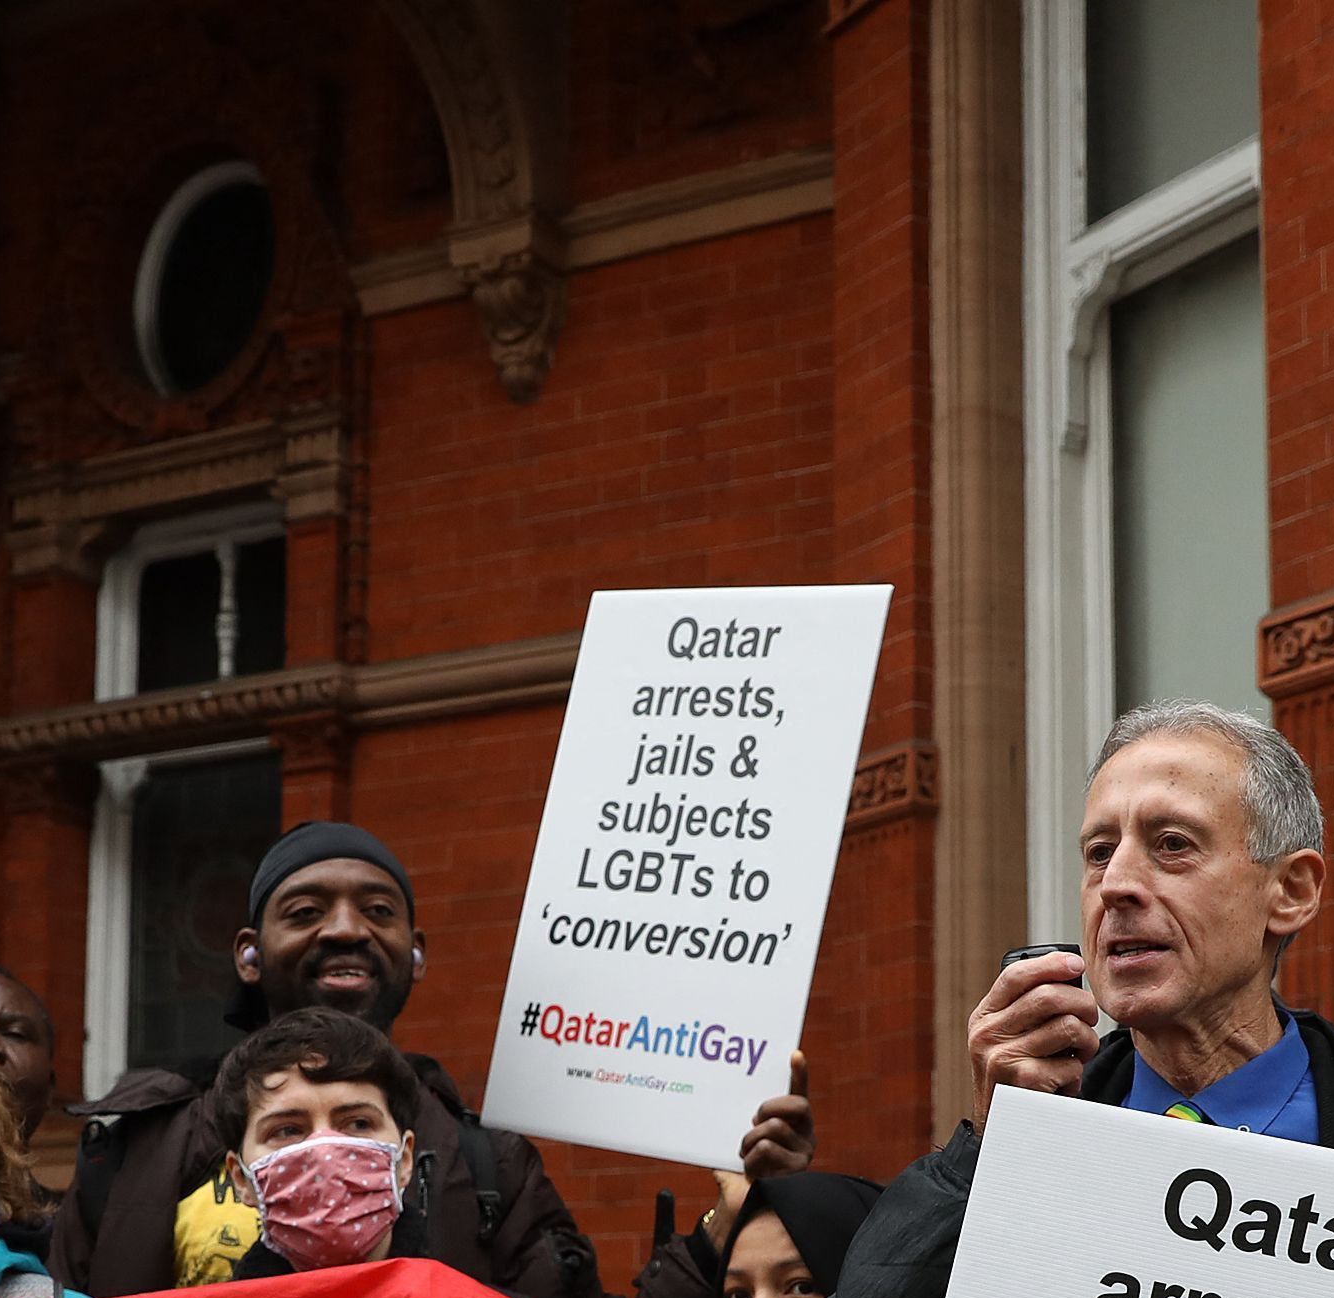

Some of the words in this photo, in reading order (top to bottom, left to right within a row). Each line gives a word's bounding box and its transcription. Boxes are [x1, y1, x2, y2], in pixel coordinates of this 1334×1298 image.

[668, 617, 781, 660] Qatar
[633, 678, 783, 726] arrests,
[628, 734, 715, 785] jails
[730, 736, 758, 778] &
[599, 793, 771, 846] subjects
[578, 849, 713, 897] LGBTs
[730, 860, 769, 901] to
[543, 904, 791, 965] ‘conversion’
[520, 1003, 767, 1075] #QatarAntiGay
[566, 1067, 694, 1094] www.QatarAntiGay.com
